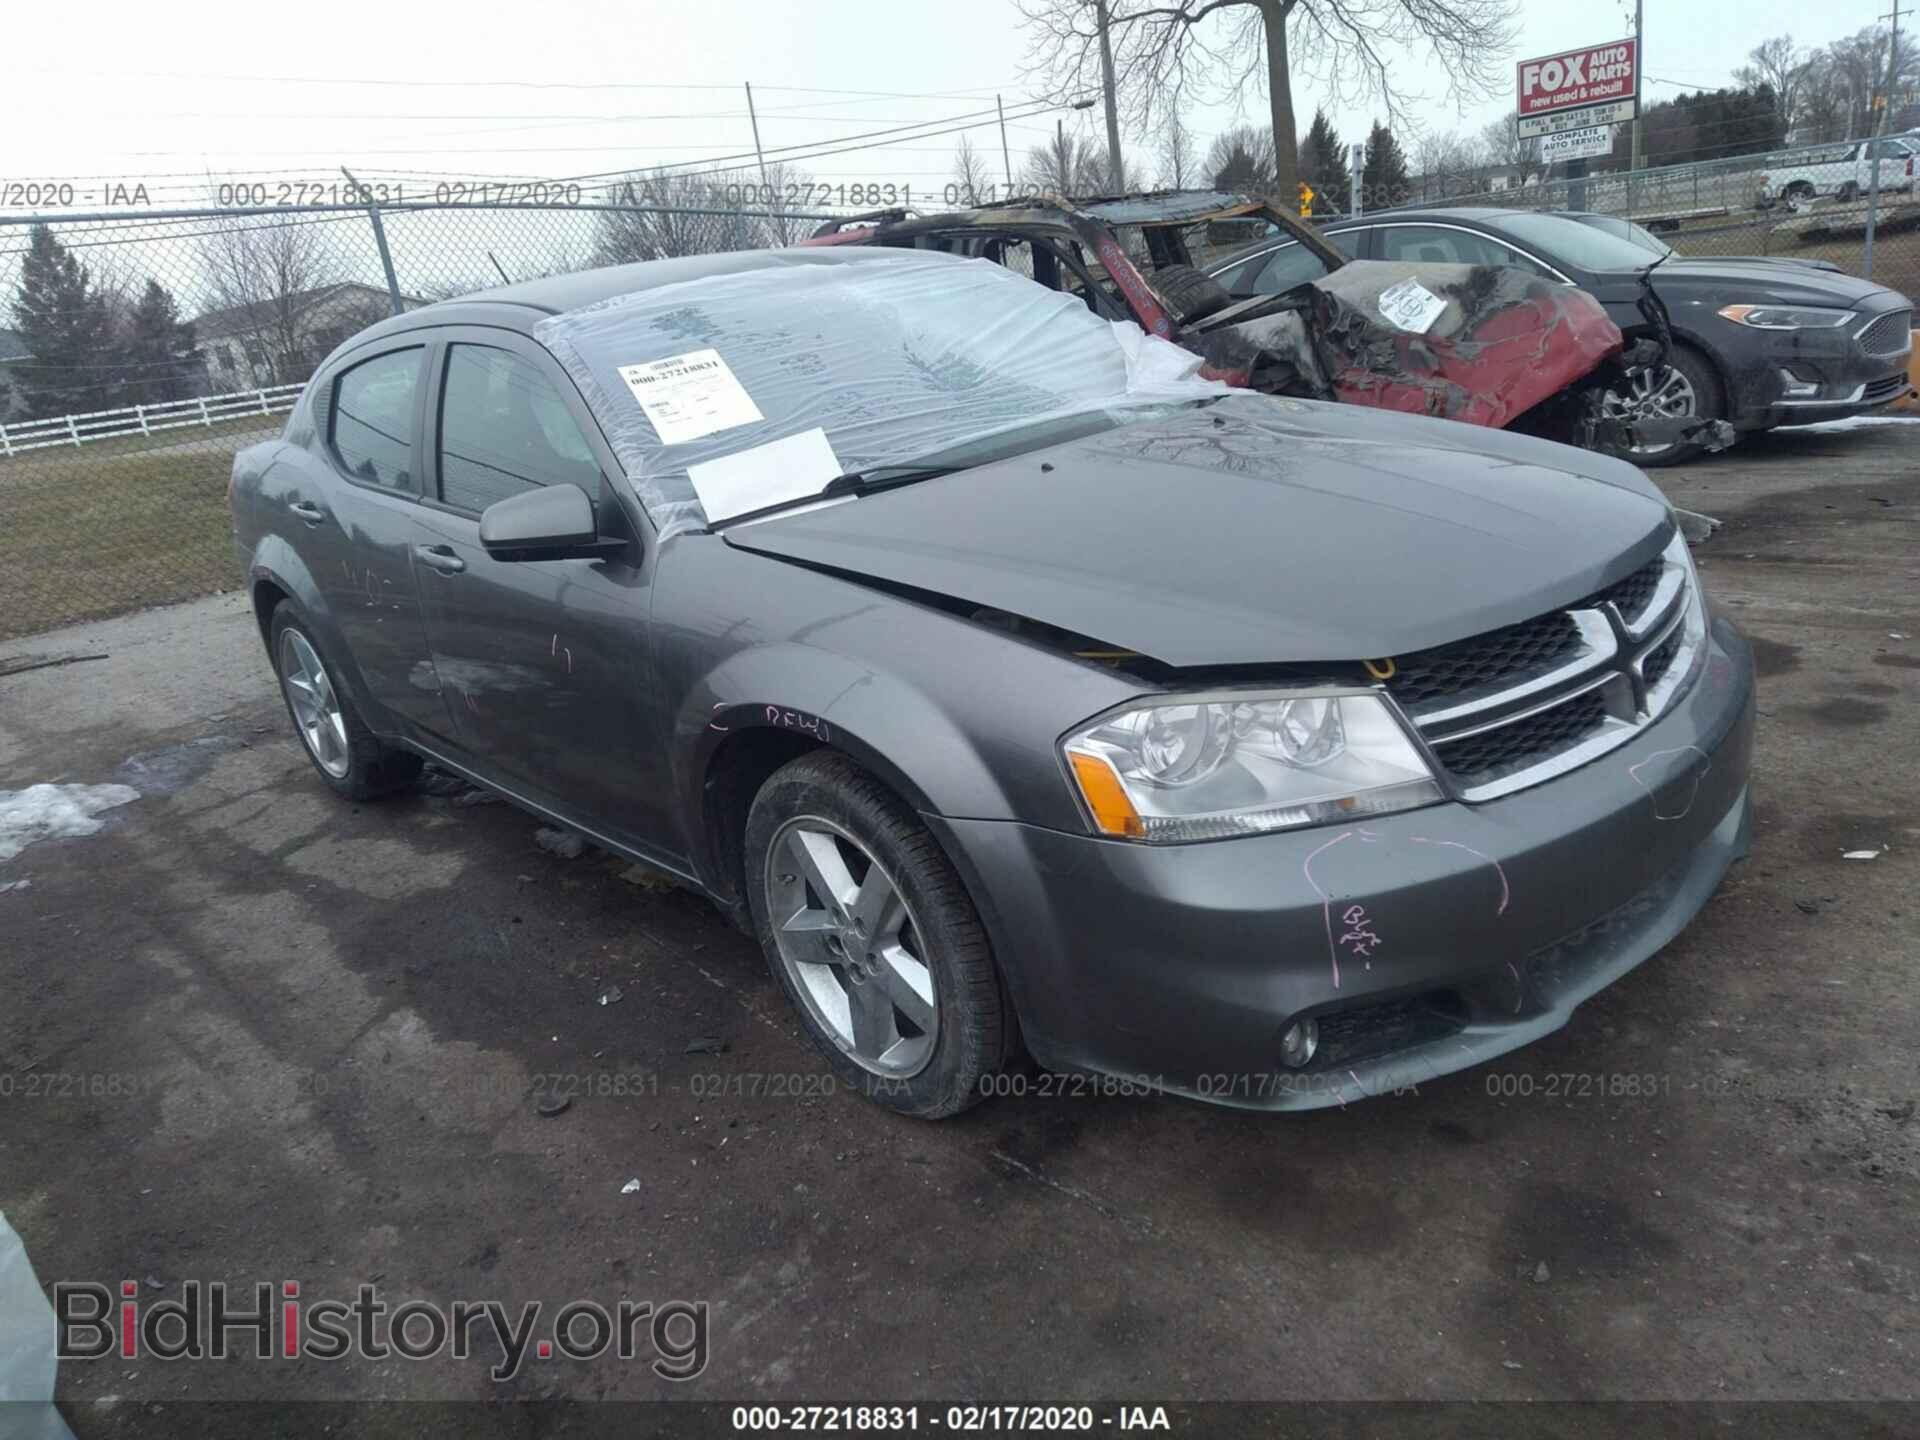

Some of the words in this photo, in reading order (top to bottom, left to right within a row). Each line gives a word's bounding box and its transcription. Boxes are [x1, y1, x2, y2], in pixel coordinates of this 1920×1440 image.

[1589, 46, 1628, 67] AUTO
[1523, 55, 1587, 96] FOX
[1589, 61, 1632, 82] PARTS
[1530, 96, 1550, 108] new
[1553, 89, 1577, 102] used
[1579, 87, 1589, 98] &
[1590, 80, 1623, 97] rebuilt
[1543, 140, 1569, 151] AUTO
[1571, 133, 1608, 146] SERVICE
[1551, 127, 1599, 142] COMPLETE
